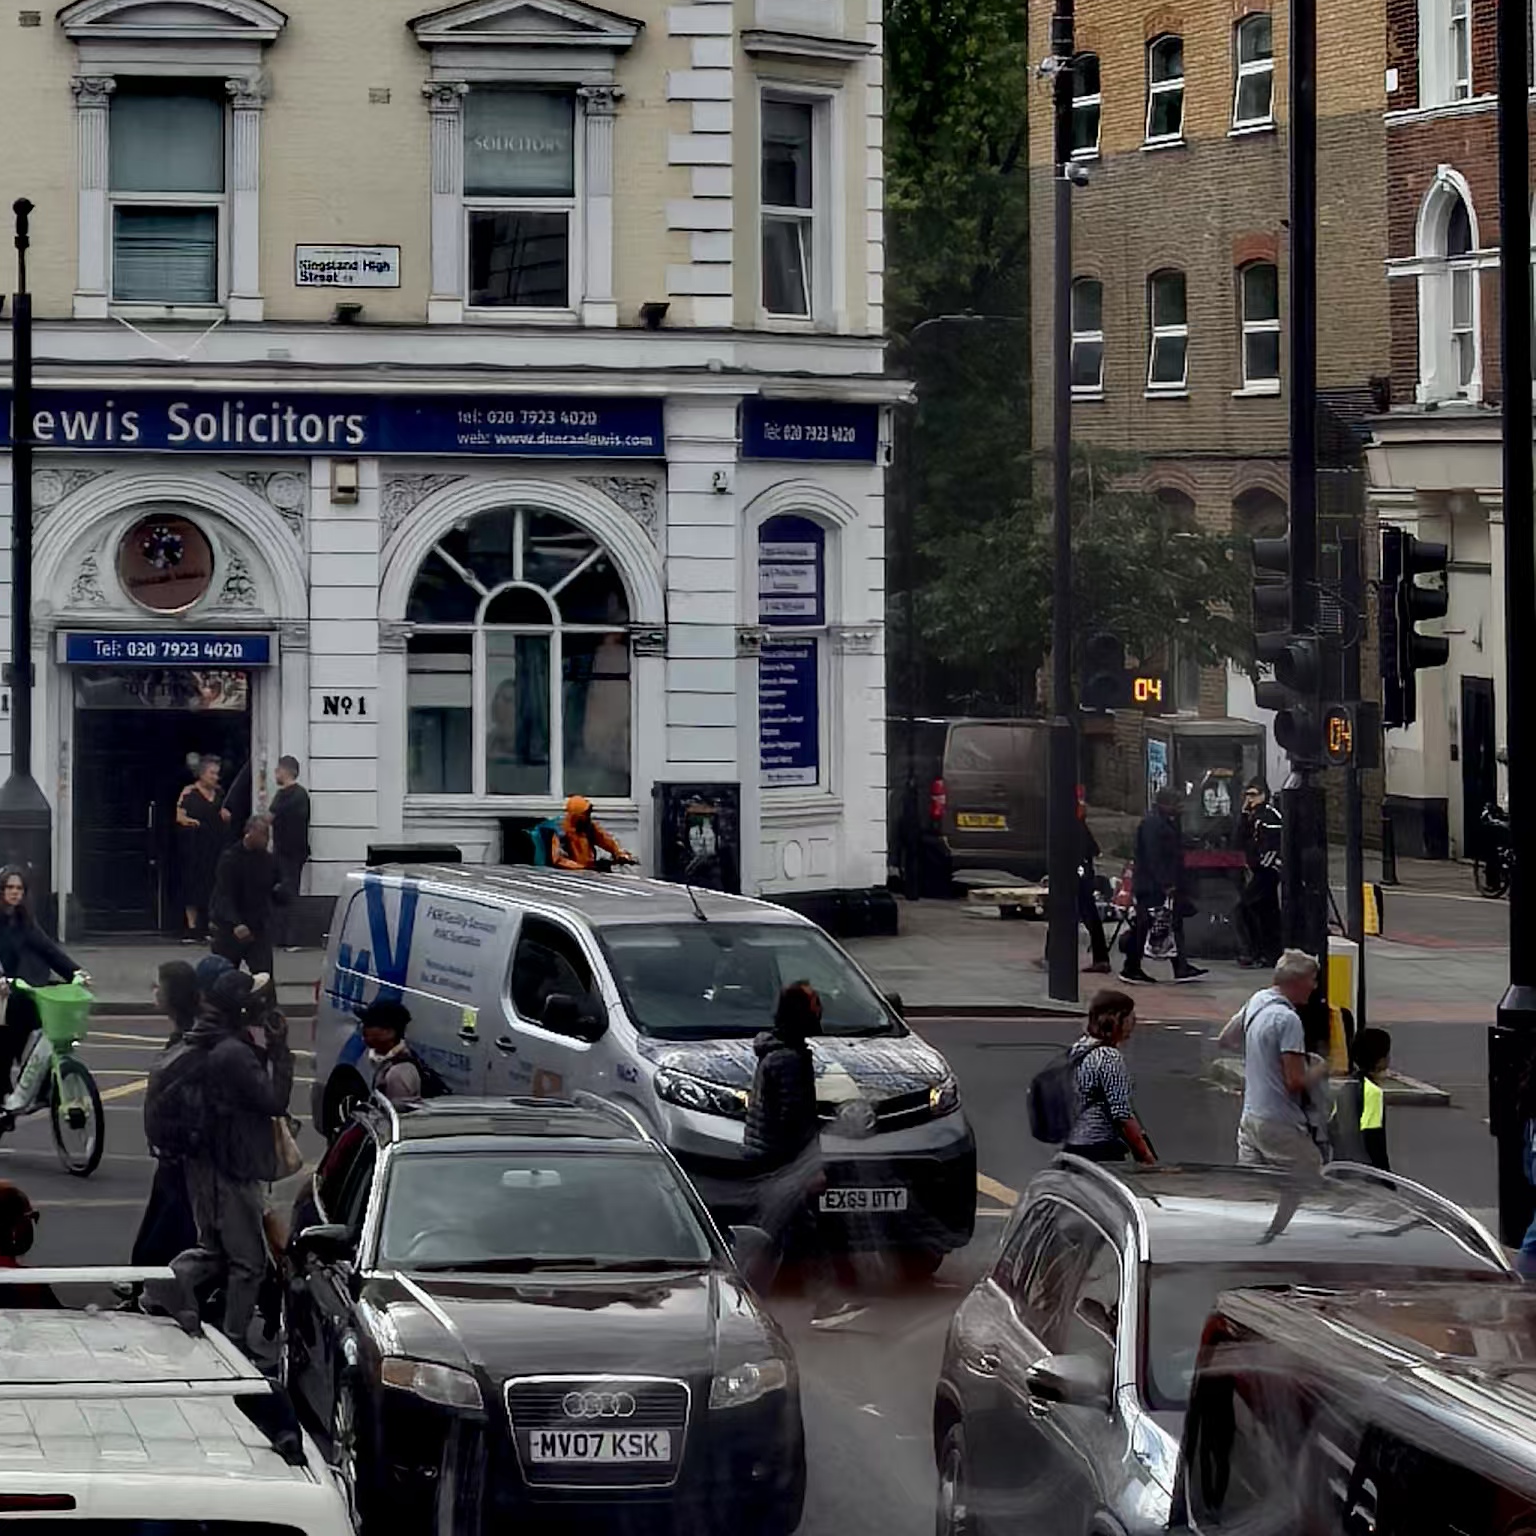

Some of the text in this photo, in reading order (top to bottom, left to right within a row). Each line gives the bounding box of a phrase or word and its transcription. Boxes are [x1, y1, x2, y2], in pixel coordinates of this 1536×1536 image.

[10, 400, 140, 441] ewis
[167, 401, 365, 445] Solicitors
[487, 411, 514, 424] 020
[520, 410, 555, 425] 7923
[561, 410, 598, 426] 4020
[94, 640, 243, 658] Tel: 020 7923 4020
[1134, 677, 1162, 701] 04
[357, 696, 366, 715] 1
[1329, 716, 1353, 752] 04
[541, 1433, 658, 1457] MV07 KSK
